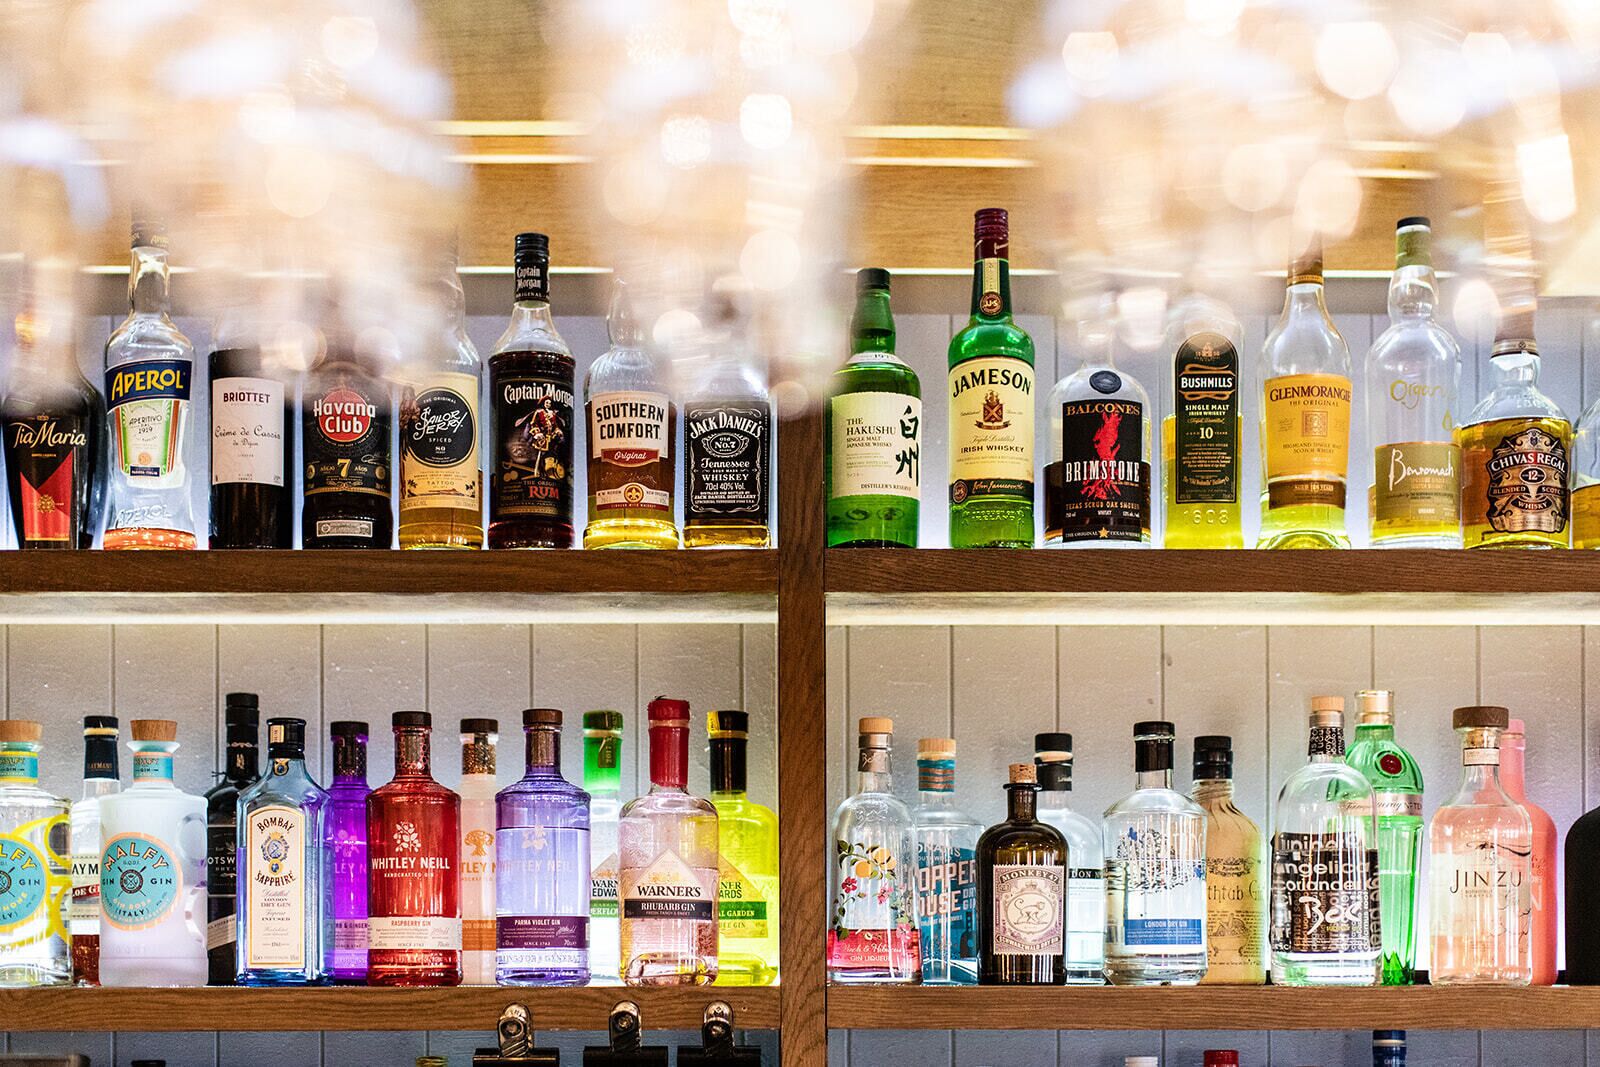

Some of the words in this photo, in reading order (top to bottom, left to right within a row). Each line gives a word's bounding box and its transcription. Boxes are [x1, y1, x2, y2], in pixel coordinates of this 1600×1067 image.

[517, 266, 540, 278] Captain
[111, 369, 185, 401] APEROL
[953, 368, 1032, 397] JAMESON
[1181, 377, 1233, 388] BUSHMILLS
[223, 392, 271, 403] BRIOTTET
[504, 383, 543, 404] Captain
[1270, 385, 1351, 402] GLENMORANGIE
[314, 399, 376, 417] Havana
[596, 402, 664, 423] SOUTHERN
[1067, 403, 1140, 416] BALCONES
[325, 416, 363, 433] Club
[600, 422, 661, 441] COMFORT
[690, 416, 717, 438] JACK
[718, 411, 764, 438] DANIEL'S
[847, 426, 896, 436] HAKUSHU
[10, 421, 34, 448] Tia
[31, 421, 87, 448] Maria
[240, 427, 249, 436] de
[254, 425, 281, 439] Cassis
[1199, 426, 1214, 439] 10
[986, 445, 1024, 453] WHISKEY
[614, 452, 647, 461] Original
[701, 457, 750, 469] Tennessee
[1491, 452, 1535, 473] CHIVAS
[1536, 453, 1566, 473] REGAL
[337, 459, 351, 477] 7
[1066, 460, 1140, 483] BRIMSTONE
[1527, 470, 1539, 480] 12
[702, 473, 749, 481] WHISKEY
[529, 485, 560, 500] RUM
[1493, 486, 1526, 494] BLENDED
[1518, 502, 1547, 510] WHISKY
[256, 816, 296, 833] BOMBAY
[104, 841, 170, 872] MALFY
[371, 857, 416, 870] WHITLEY
[420, 856, 450, 870] NEILL
[19, 878, 40, 886] GIN
[150, 877, 172, 886] GIN
[255, 869, 296, 886] SAPPHIRE
[1001, 869, 1047, 881] MONKEY
[1048, 873, 1059, 882] 47
[1450, 869, 1522, 893] JINZU
[637, 885, 701, 898] WARNER'S
[641, 902, 680, 911] RHUBARB
[681, 903, 696, 911] GIN
[905, 890, 961, 917] OUSE
